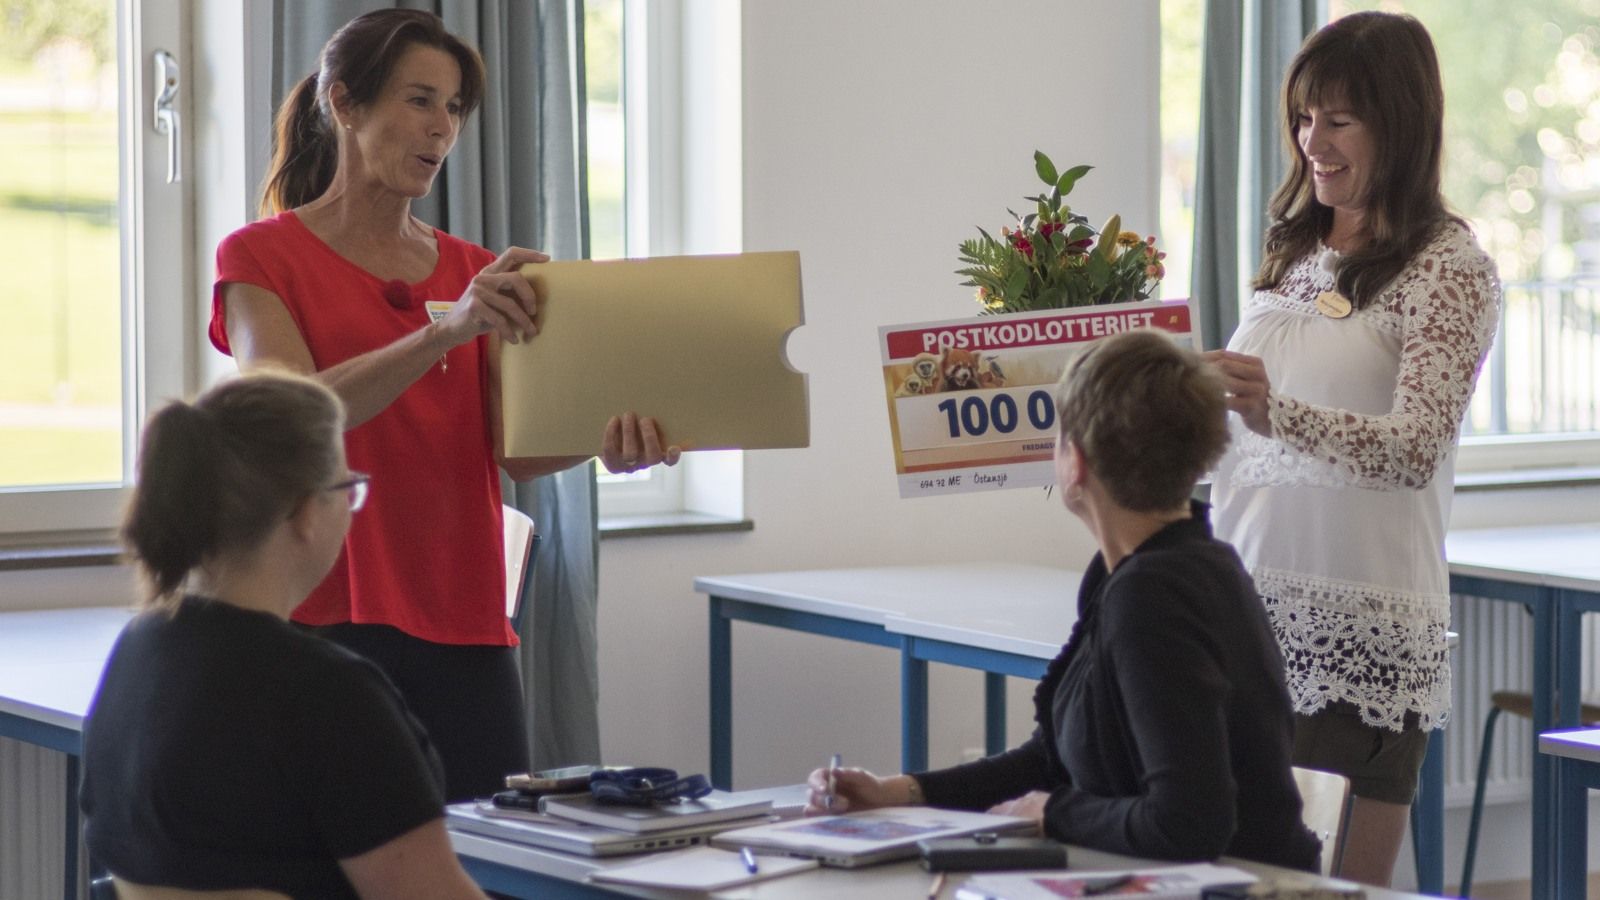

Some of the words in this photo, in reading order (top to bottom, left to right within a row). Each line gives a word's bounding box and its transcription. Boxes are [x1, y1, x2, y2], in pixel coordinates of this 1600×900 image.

[922, 312, 1154, 351] POSTKODLOTTERIET
[938, 393, 1018, 438] 100
[948, 475, 961, 487] ME
